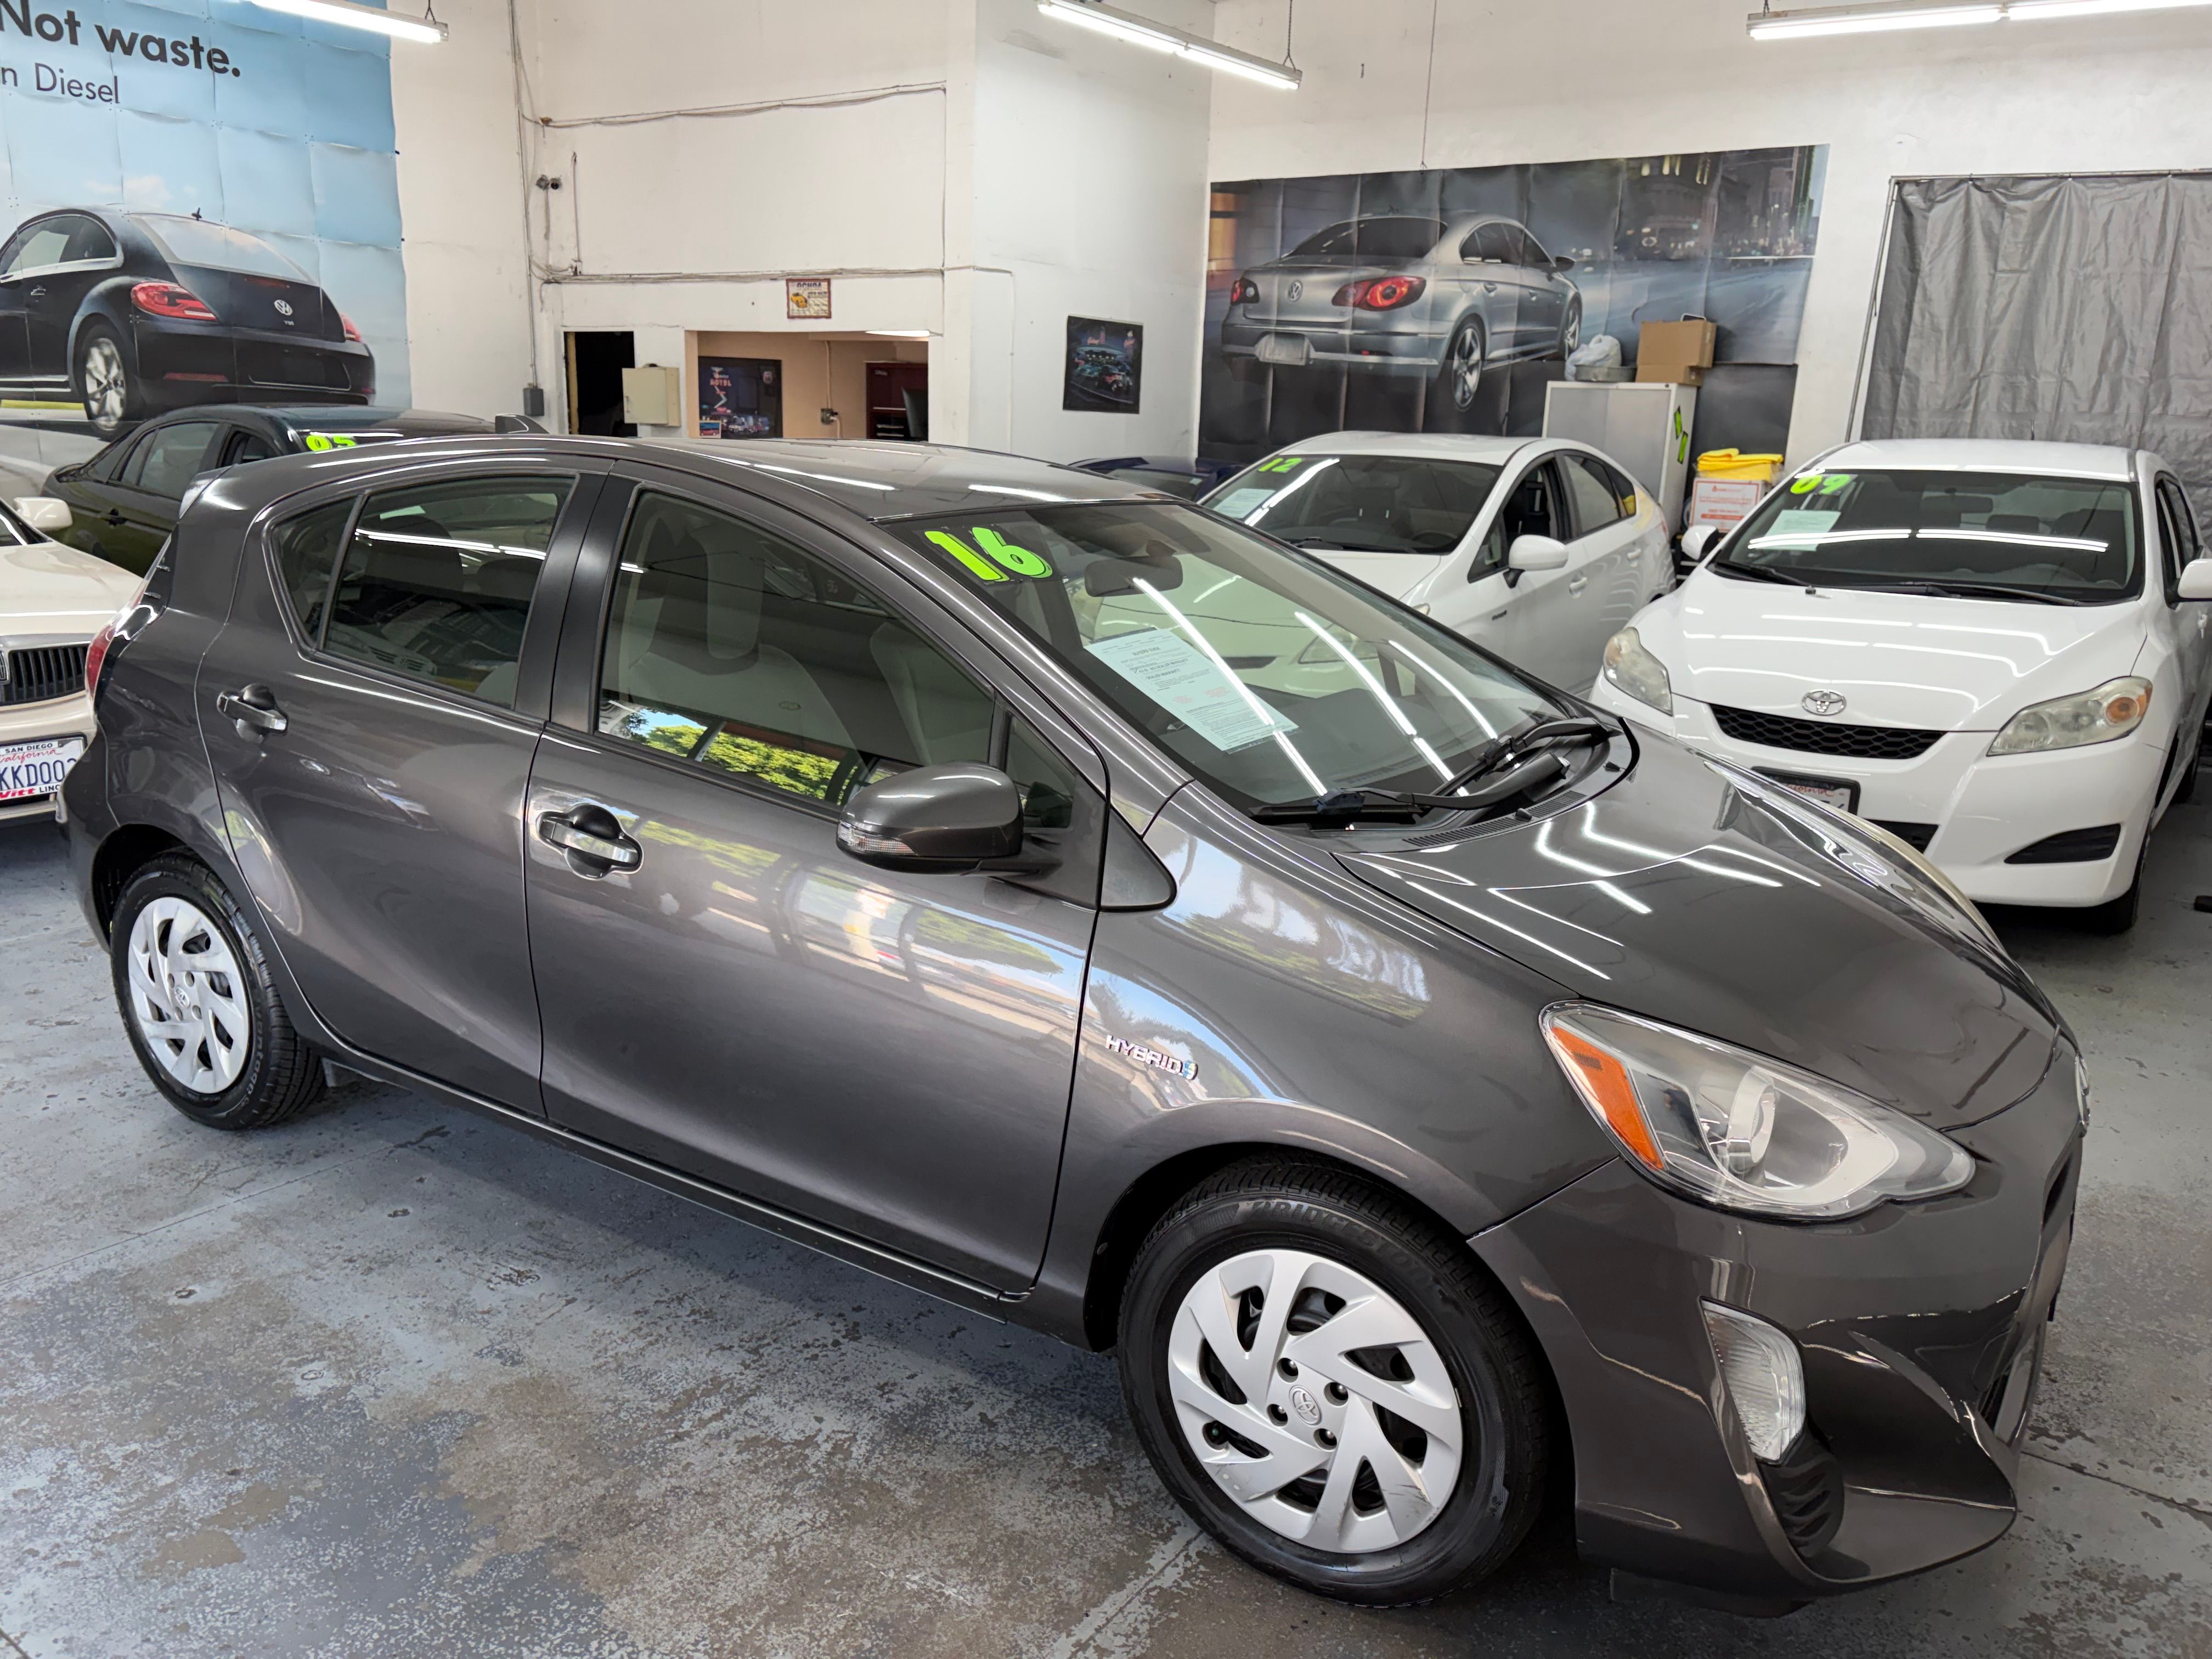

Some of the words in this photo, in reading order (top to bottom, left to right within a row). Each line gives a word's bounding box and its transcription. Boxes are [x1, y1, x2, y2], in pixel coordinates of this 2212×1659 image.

[0, 0, 81, 46] Not
[94, 24, 241, 78] waste.
[35, 63, 120, 104] Diesel
[1257, 458, 1302, 473] 12
[1790, 473, 1850, 495] 09
[924, 527, 1053, 582] 16
[0, 758, 77, 791] KKD00
[1105, 1034, 1184, 1076] HYBRID
